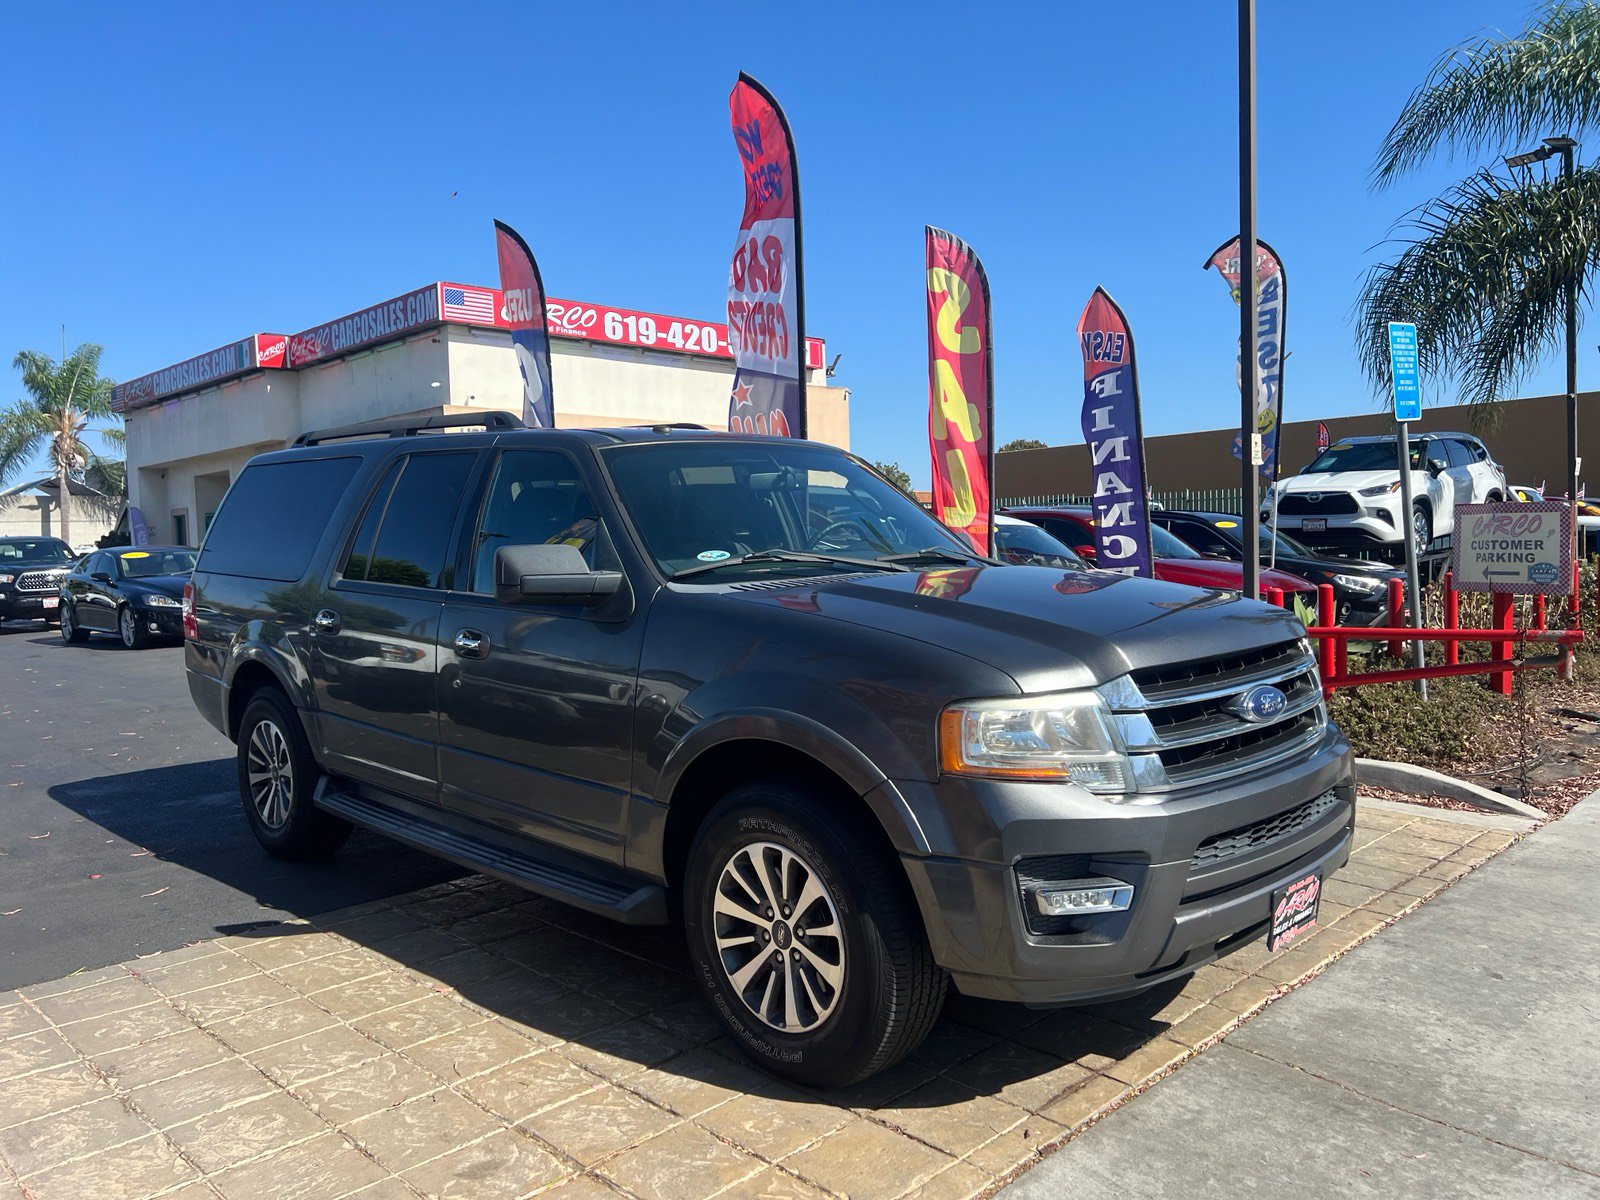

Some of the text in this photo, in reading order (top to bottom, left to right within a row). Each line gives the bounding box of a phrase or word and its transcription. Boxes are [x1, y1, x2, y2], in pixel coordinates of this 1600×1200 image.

[290, 288, 438, 361] CARCO CARCOSALES.COM
[556, 326, 587, 336] Finance
[604, 311, 735, 357] 619-420-
[258, 341, 286, 361] CARCO
[153, 347, 237, 394] CARCOSALES.COM
[1471, 513, 1543, 538] CARCO
[1471, 540, 1544, 551] CUSTOMER
[1475, 552, 1536, 563] PARKING
[1259, 692, 1284, 714] Ford
[739, 818, 832, 878] PATHFINDER
[1273, 880, 1320, 927] CARCO
